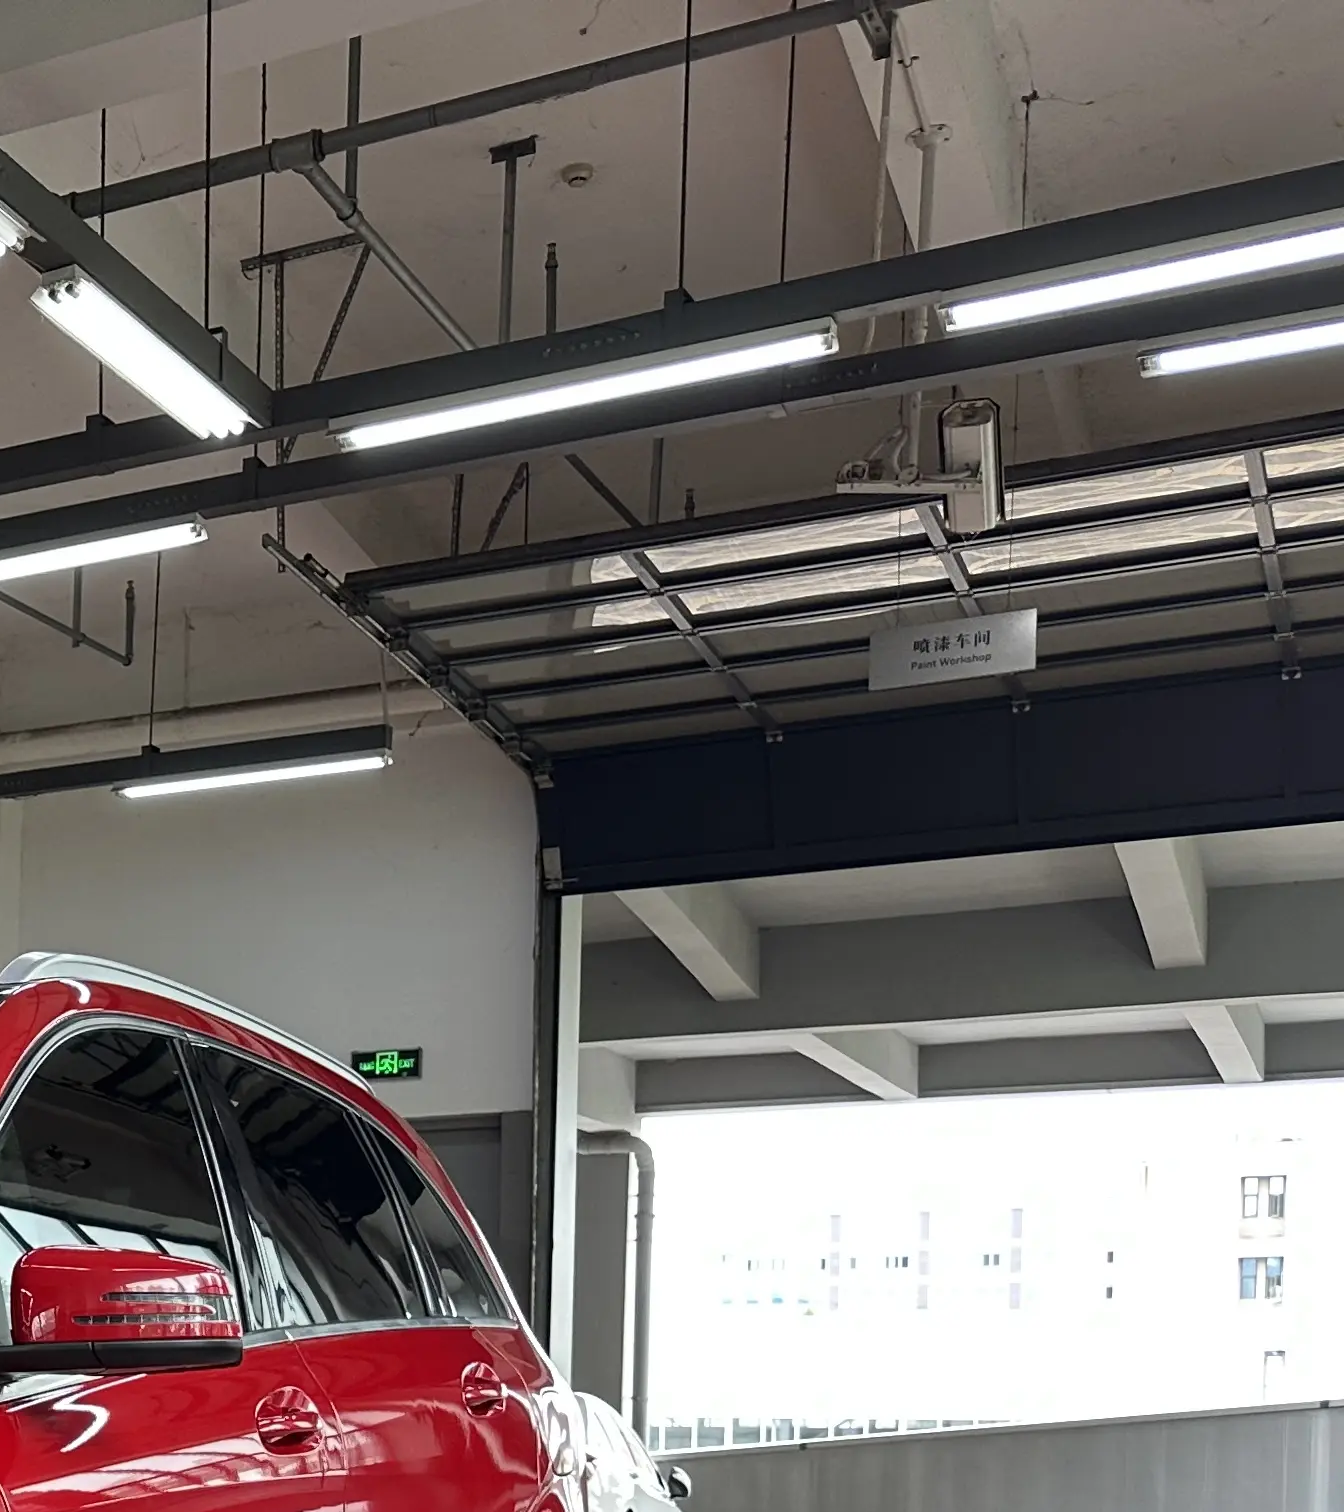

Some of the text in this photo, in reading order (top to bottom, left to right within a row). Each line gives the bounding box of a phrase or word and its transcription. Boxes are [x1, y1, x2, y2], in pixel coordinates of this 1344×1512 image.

[912, 629, 992, 654] 喷漆车间
[910, 652, 993, 671] Paint Workshop
